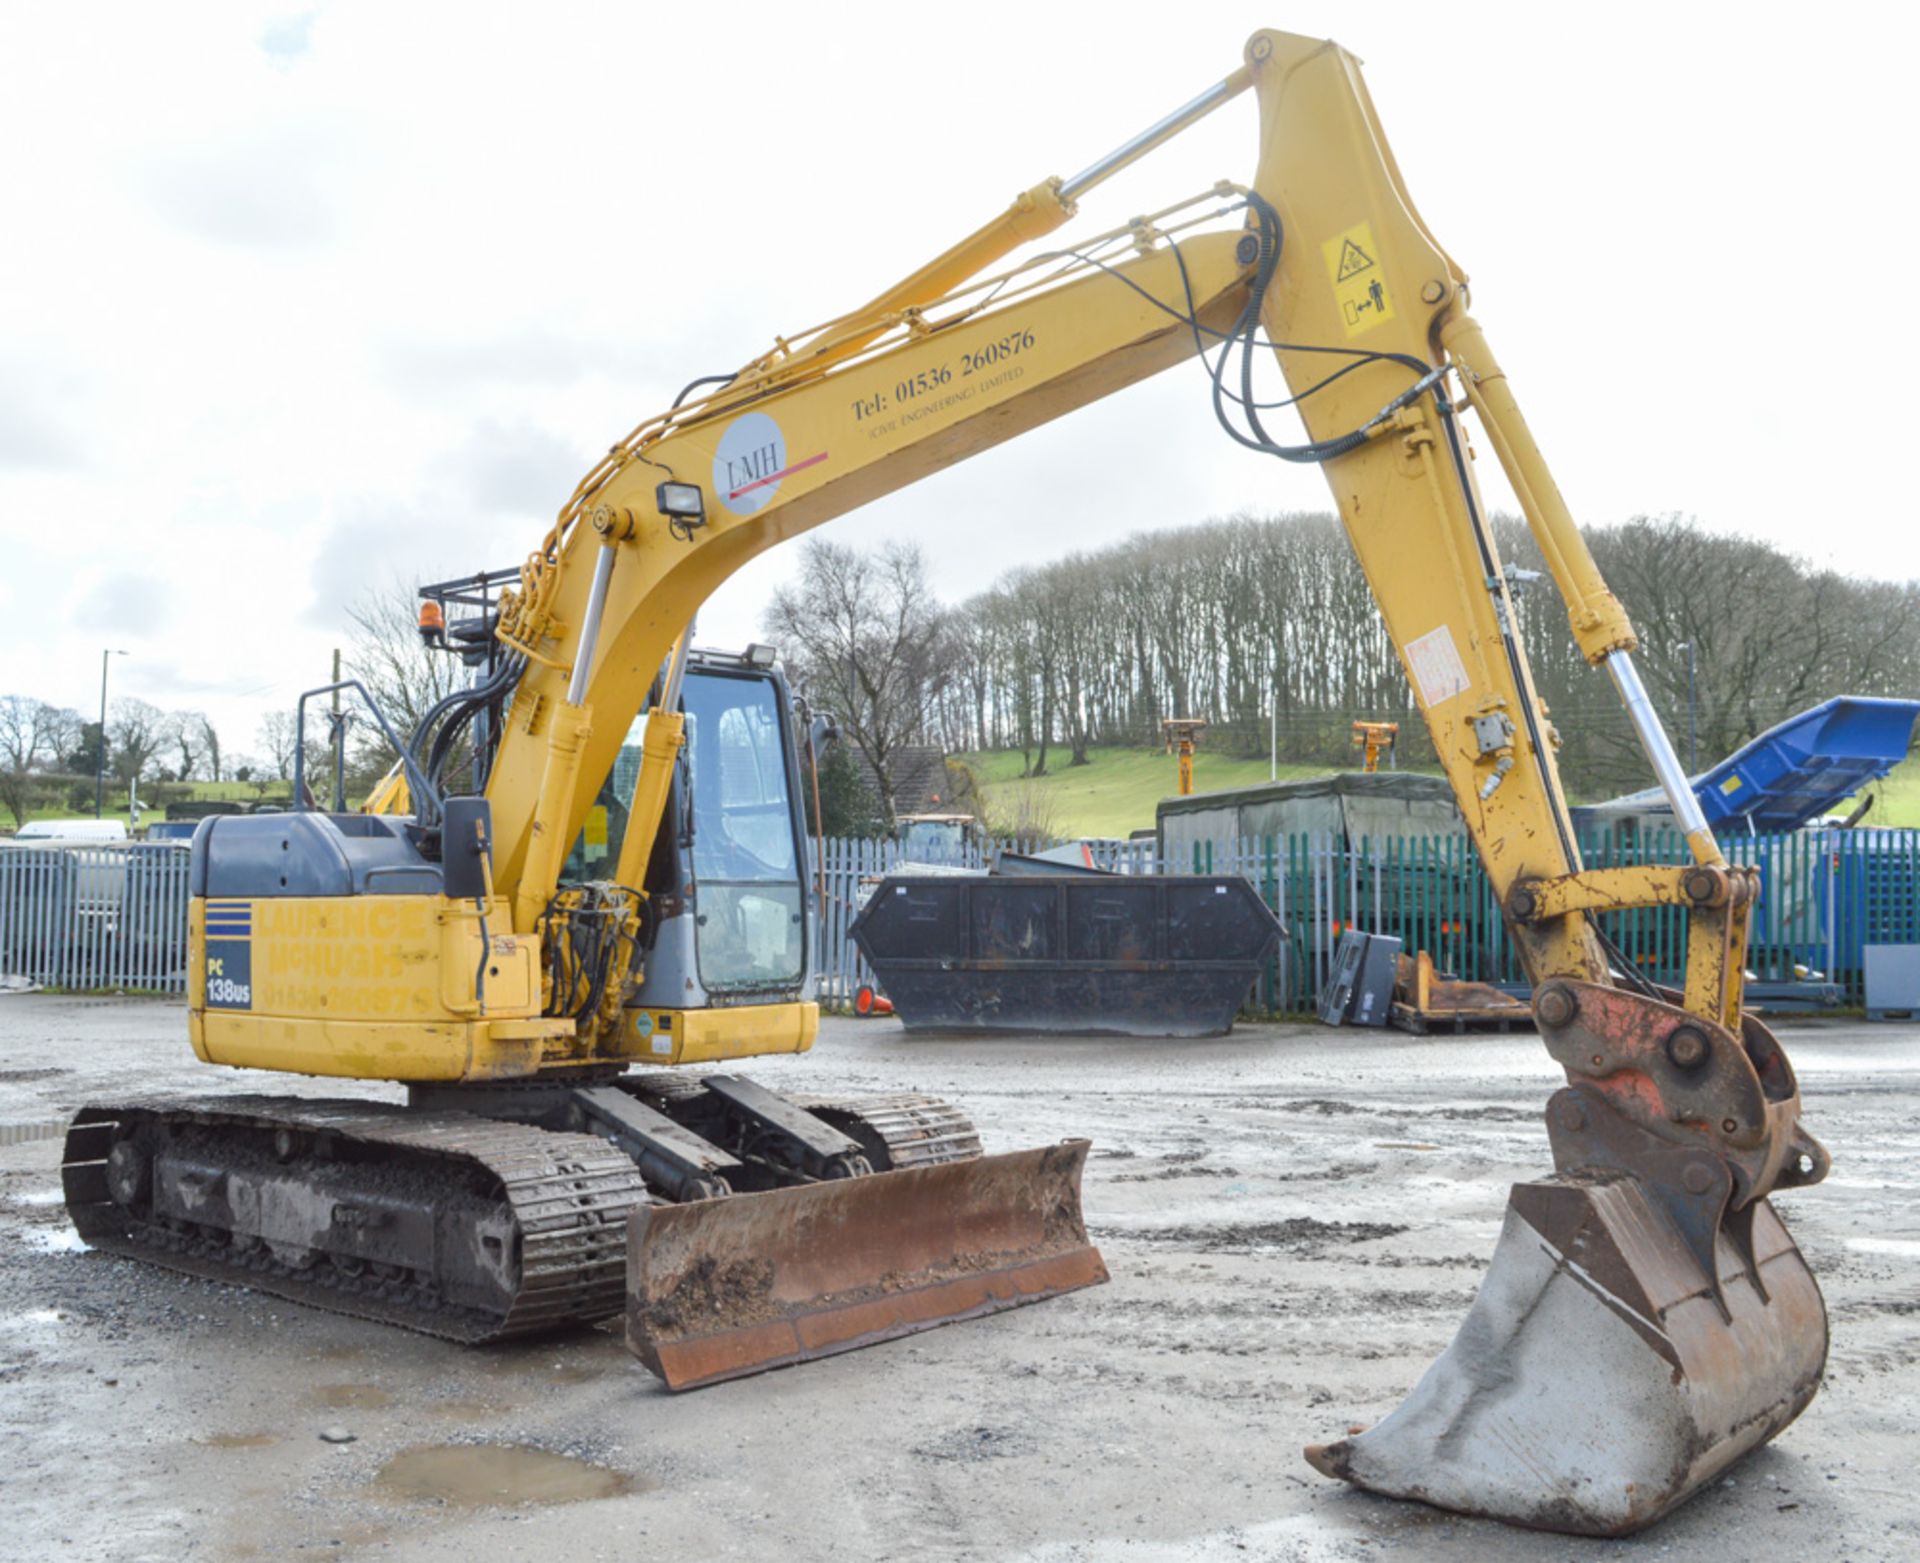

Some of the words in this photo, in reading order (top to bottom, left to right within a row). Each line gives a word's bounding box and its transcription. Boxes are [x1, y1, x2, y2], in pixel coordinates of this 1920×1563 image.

[850, 396, 888, 421] Tel:
[895, 365, 952, 404] 01536
[961, 328, 1036, 376] 260876
[980, 366, 1025, 393] LIMITED
[727, 443, 778, 490] LMH
[208, 959, 223, 976] PC
